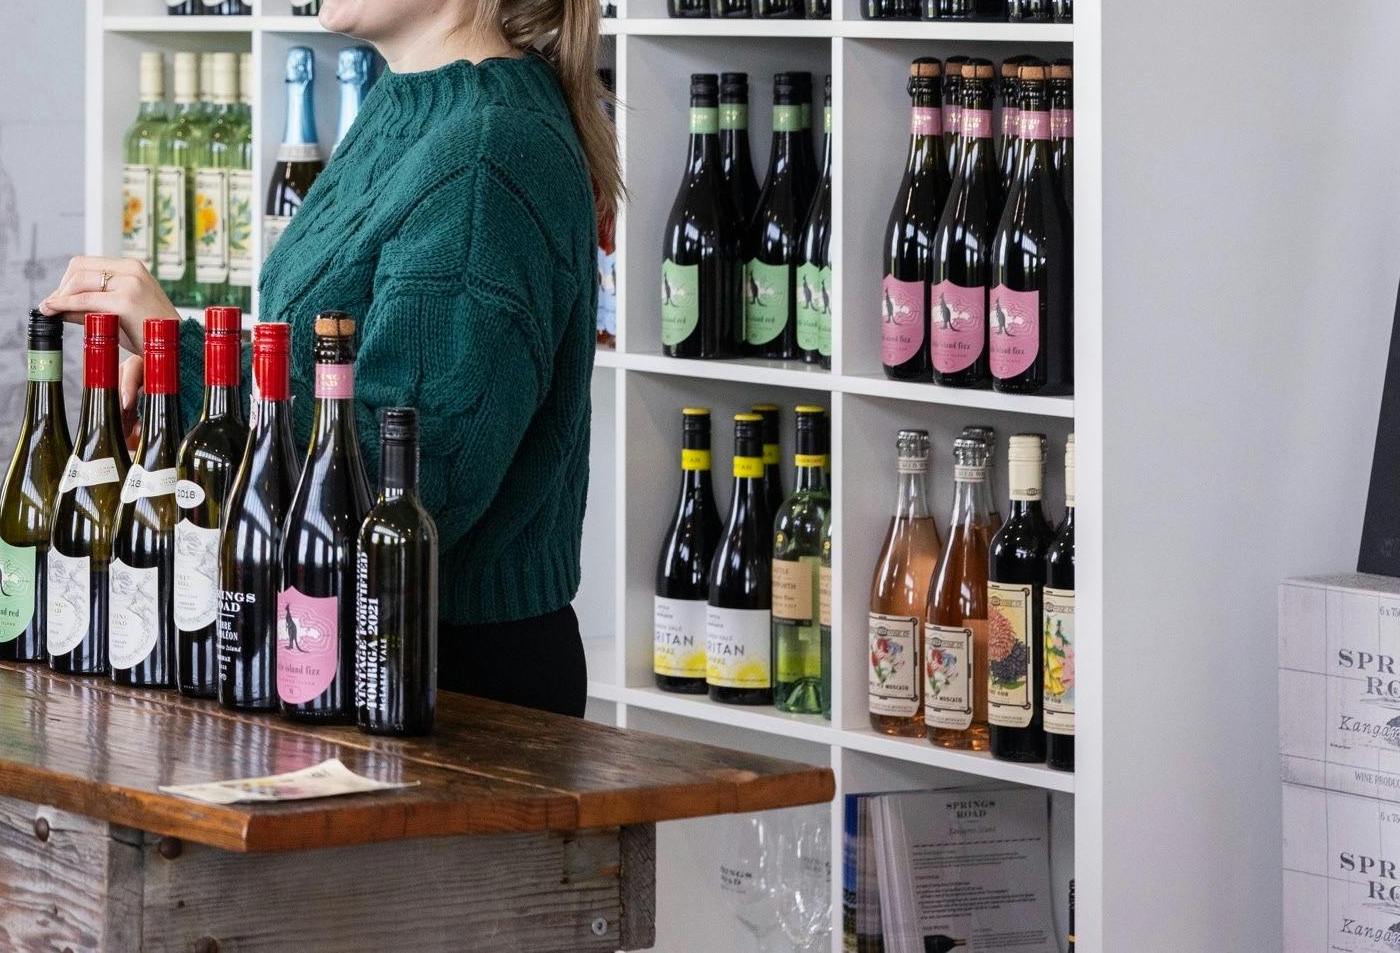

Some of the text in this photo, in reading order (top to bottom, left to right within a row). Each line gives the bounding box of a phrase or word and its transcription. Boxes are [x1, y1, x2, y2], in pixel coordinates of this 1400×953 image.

[177, 488, 195, 499] 2018
[216, 589, 256, 603] RINGS
[358, 552, 368, 636] FORTIFIED
[9, 608, 19, 617] red
[656, 631, 694, 646] RITAN
[367, 598, 378, 711] TOURIGA 2021
[708, 641, 745, 656] RITAN
[305, 665, 320, 676] fizz
[357, 639, 367, 707] VINTAGE
[1355, 771, 1373, 784] WINE
[946, 800, 996, 810] SPRINGS
[956, 811, 987, 819] ROAD
